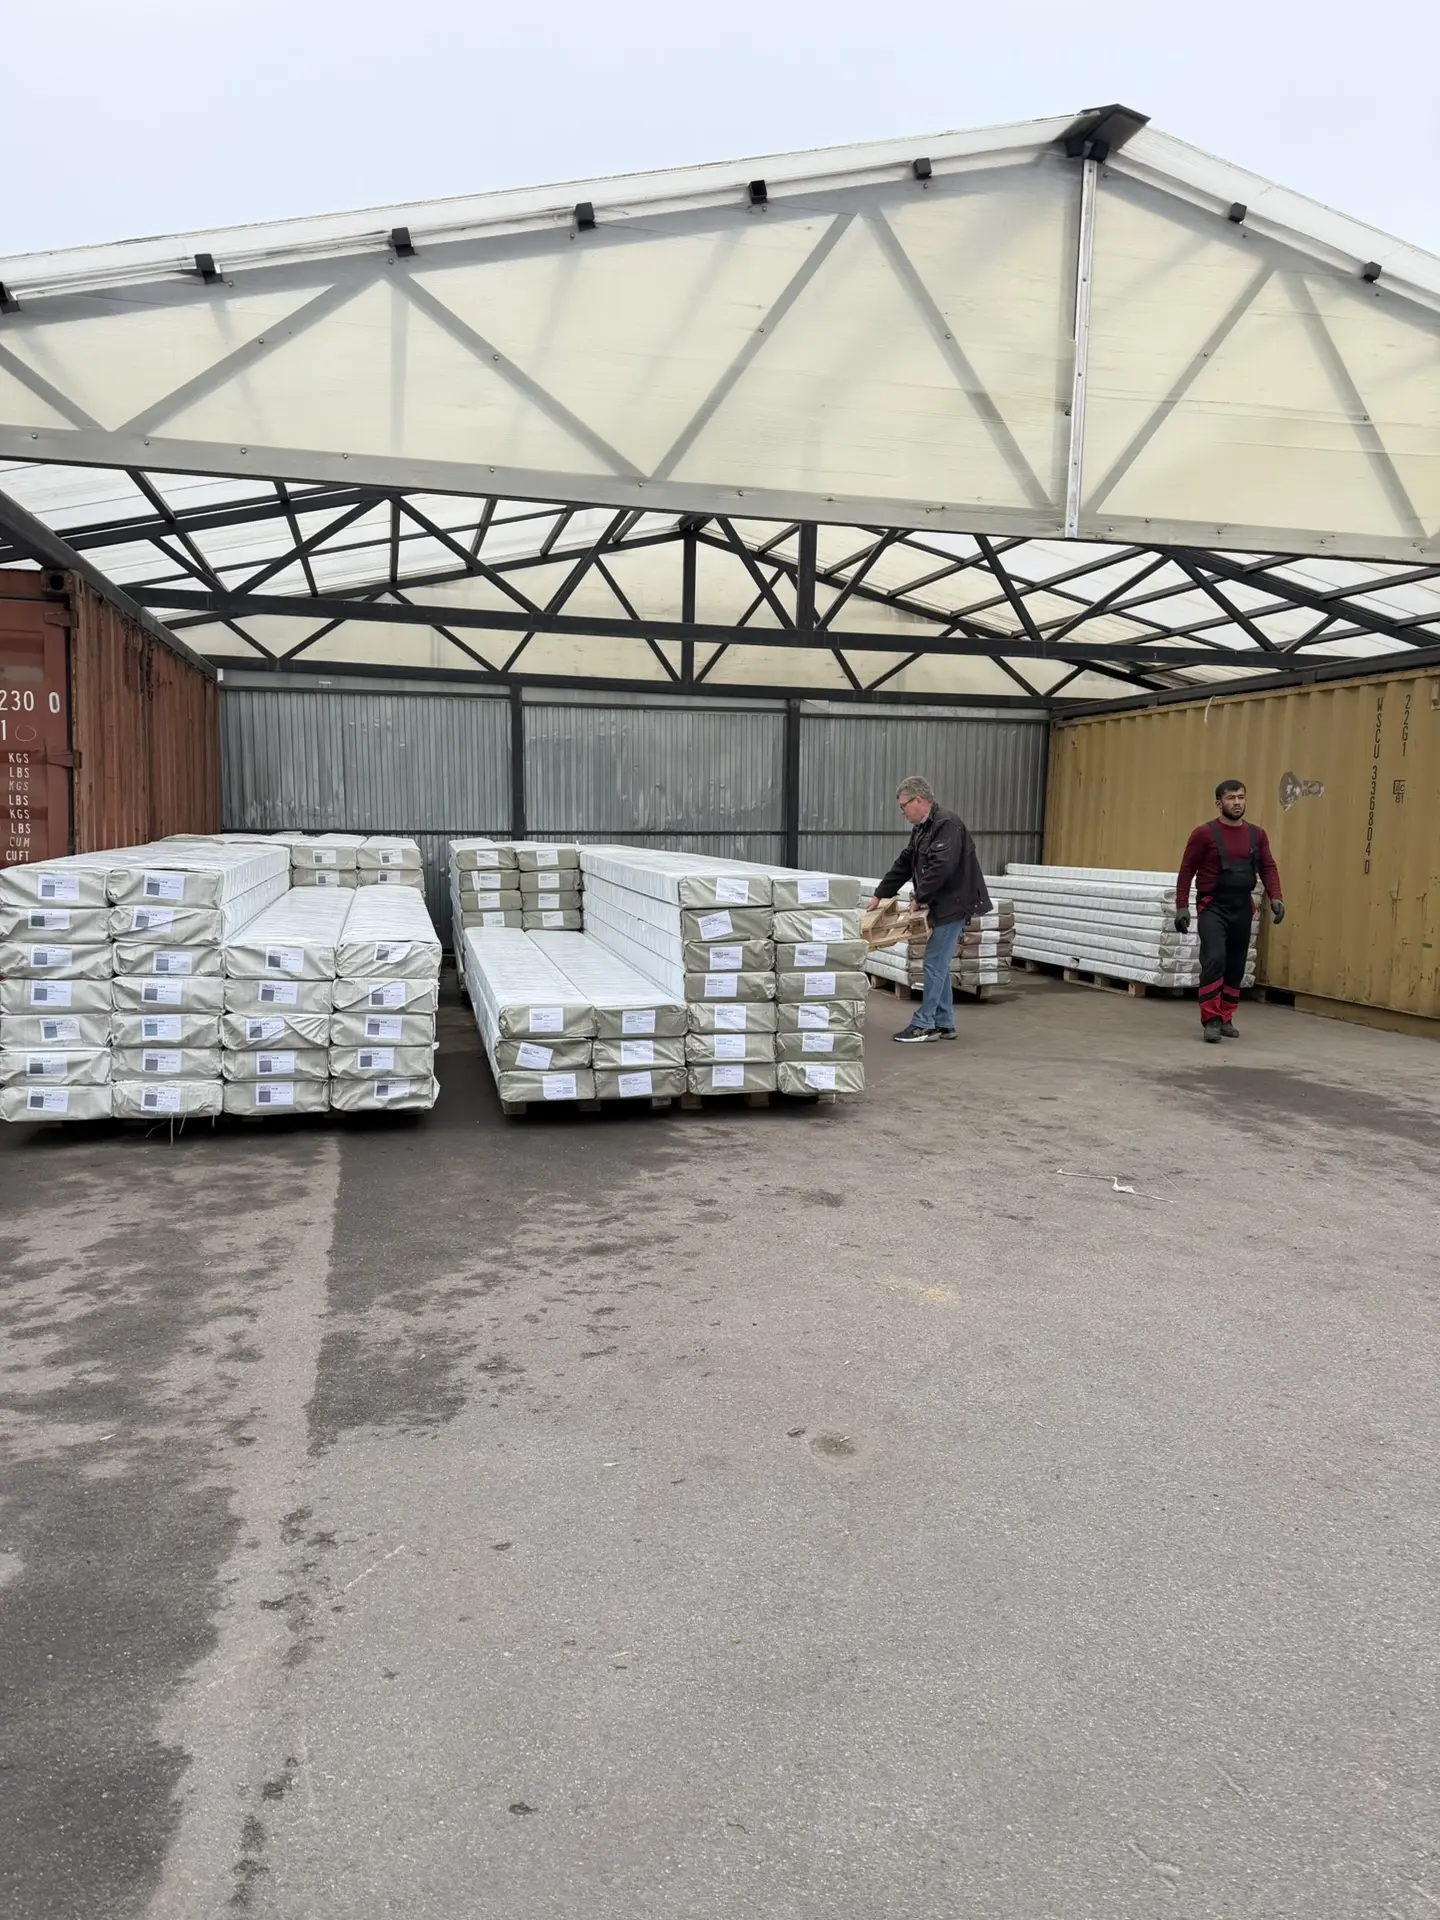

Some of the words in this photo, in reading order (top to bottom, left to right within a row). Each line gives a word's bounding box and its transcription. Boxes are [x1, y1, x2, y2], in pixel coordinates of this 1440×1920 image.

[48, 691, 61, 714] 0
[1373, 696, 1384, 759] WSCU
[1402, 694, 1411, 757] 22G1
[8, 752, 30, 764] KGS
[9, 766, 30, 778] LBS
[8, 780, 29, 791] KGS
[8, 794, 29, 806] LBS
[9, 808, 30, 819] KGS
[1365, 765, 1378, 857] 336804
[10, 822, 31, 834] LBS
[9, 836, 30, 848] CUM
